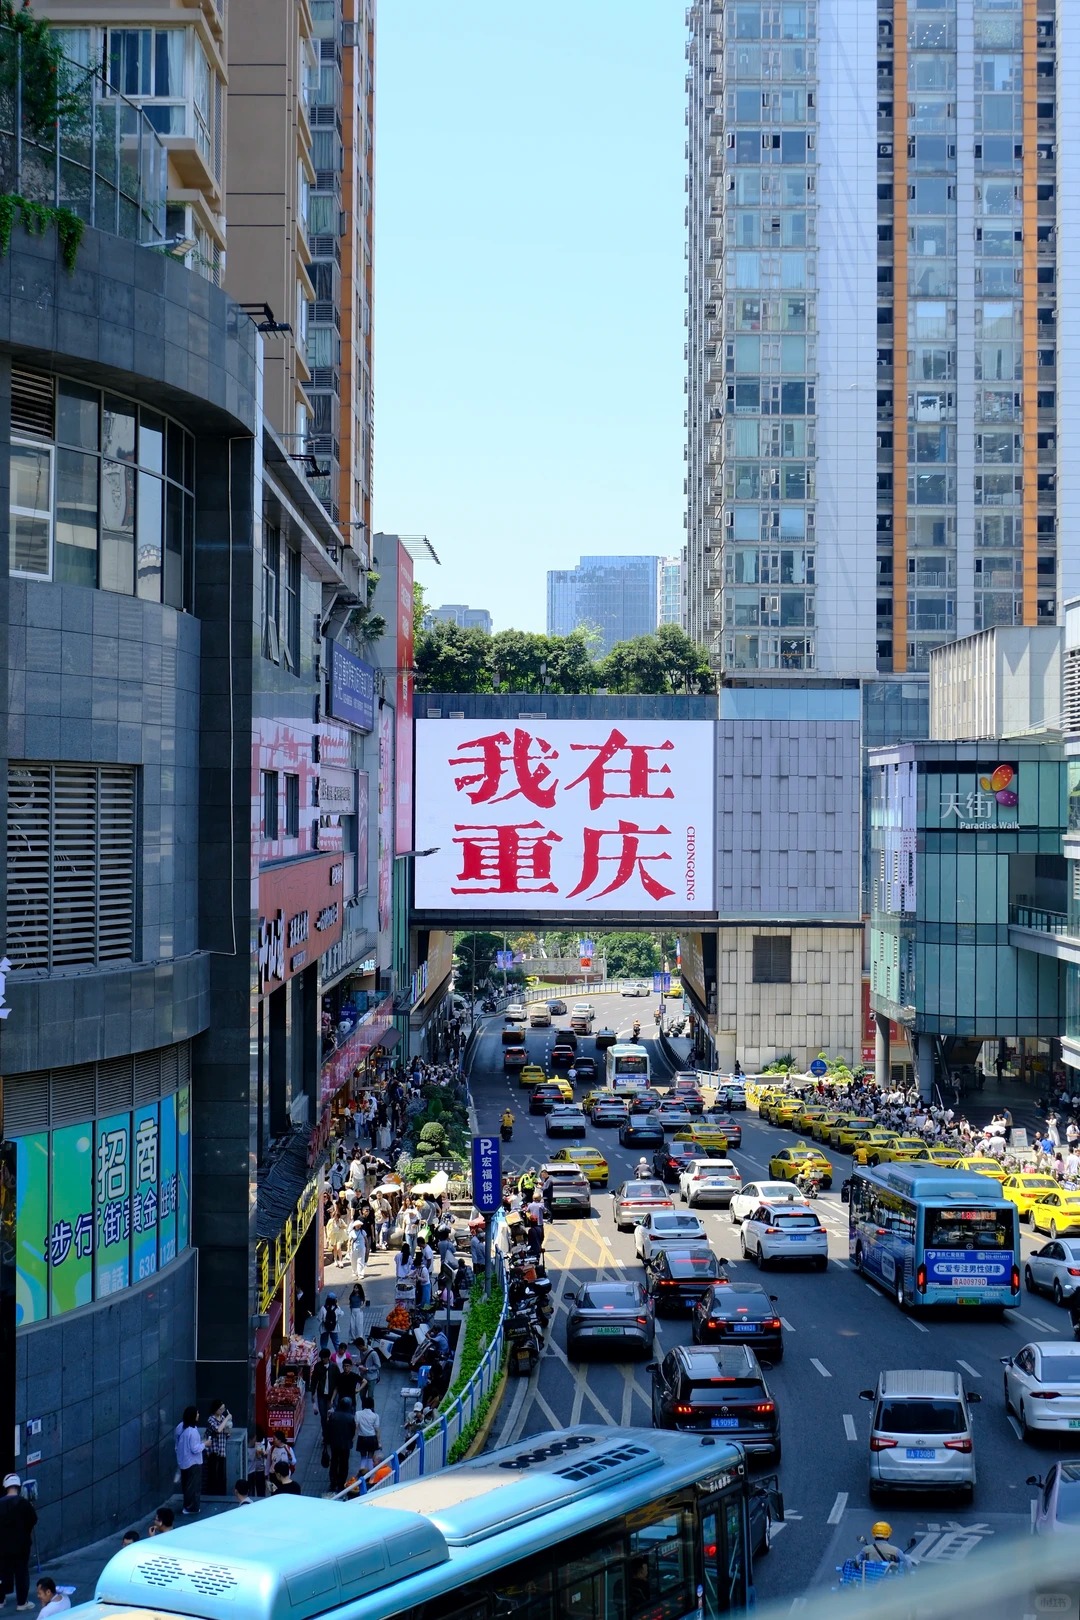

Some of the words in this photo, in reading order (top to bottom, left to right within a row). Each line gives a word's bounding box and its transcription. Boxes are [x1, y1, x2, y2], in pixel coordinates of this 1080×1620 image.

[448, 728, 675, 810] 我在
[939, 791, 993, 819] 天街
[959, 821, 997, 830] Paradise
[998, 821, 1020, 830] Walk
[451, 820, 676, 901] 重庆
[686, 826, 696, 901] CHONGQING
[97, 1118, 159, 1203] 招商
[480, 1139, 492, 1156] P
[481, 1157, 494, 1205] 宏福俊悦
[936, 1264, 1002, 1274] 仁爱专注男性健康
